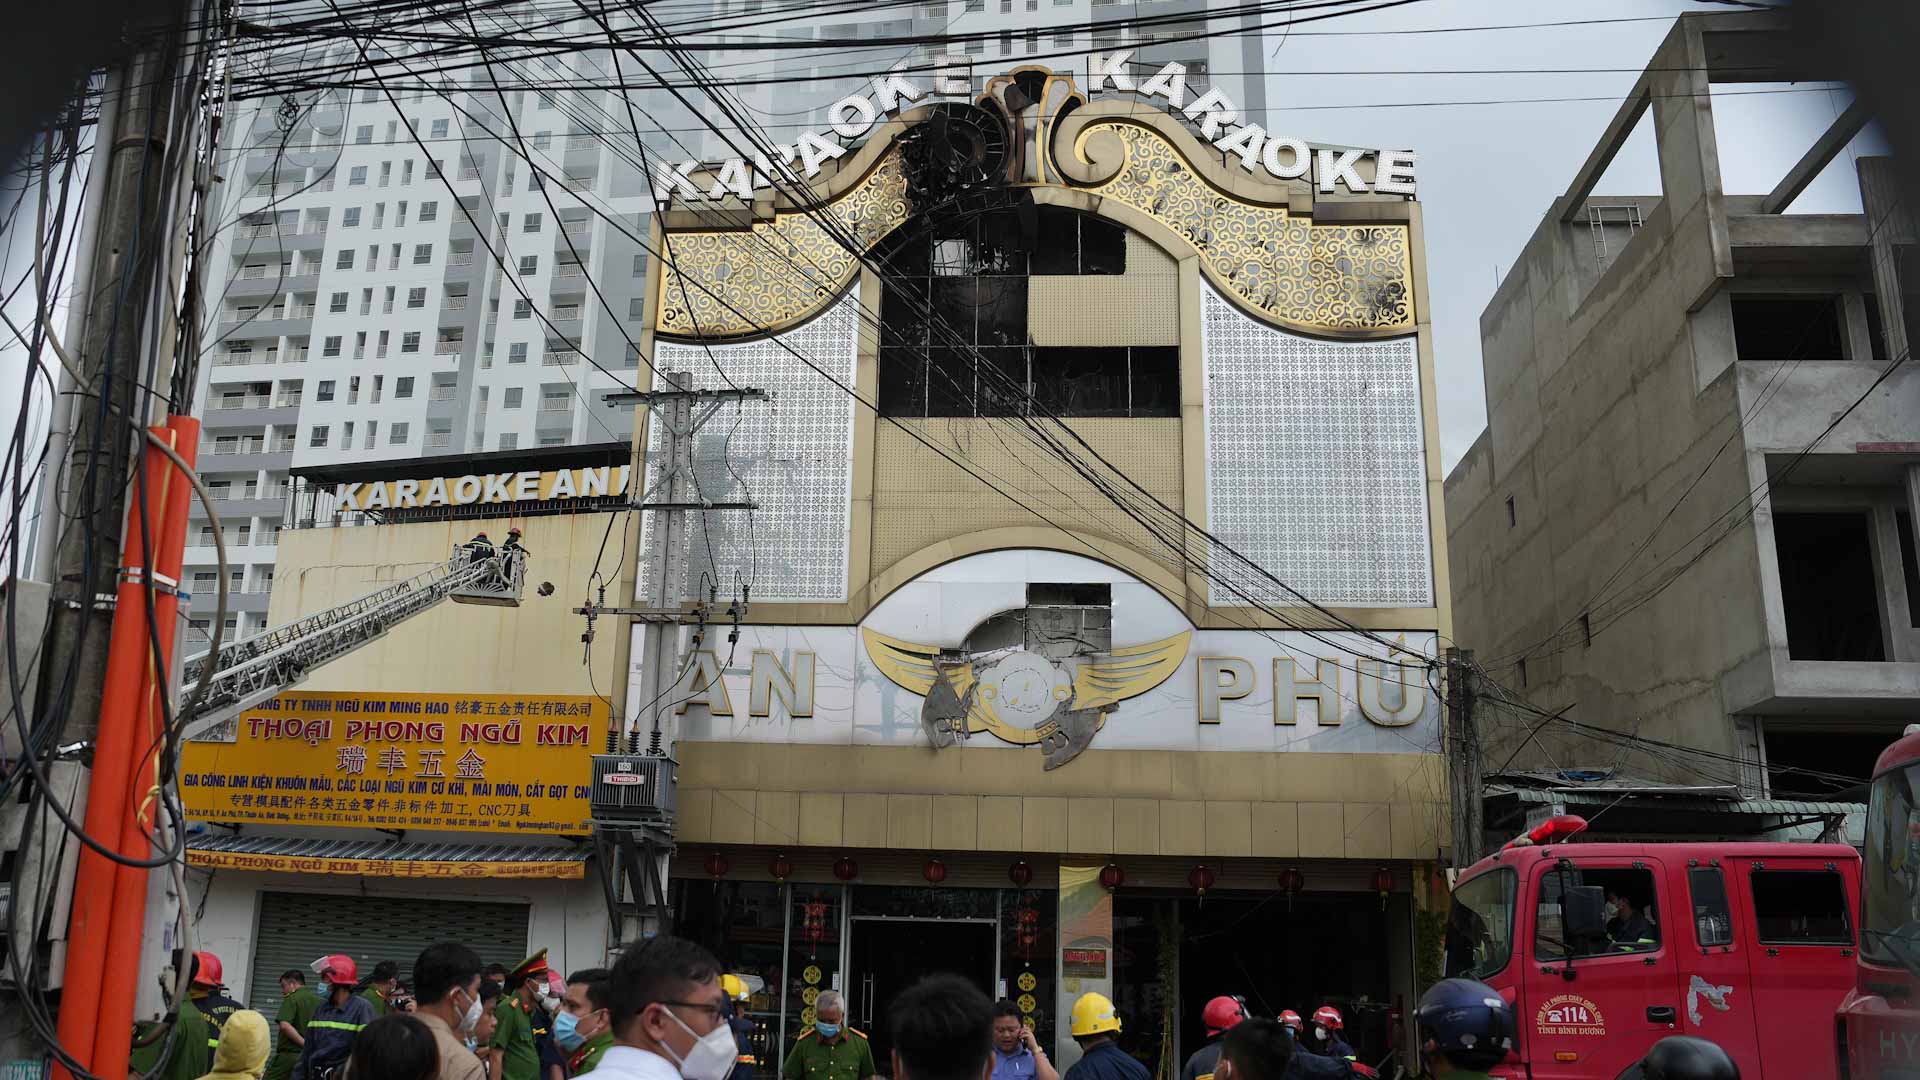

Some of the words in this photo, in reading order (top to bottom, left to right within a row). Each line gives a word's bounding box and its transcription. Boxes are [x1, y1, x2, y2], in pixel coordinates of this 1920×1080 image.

[655, 54, 973, 201] KARAOKE
[1087, 50, 1417, 194] KARAOKE
[335, 471, 541, 512] KARAOKE
[674, 649, 816, 718] AN
[1198, 632, 1426, 727] PHÚ
[285, 699, 299, 711] TY
[301, 700, 333, 712] TNHH
[363, 701, 387, 713] KIM
[389, 701, 421, 714] MING
[425, 702, 449, 715] HAO
[247, 717, 334, 746] THOẠI
[345, 719, 445, 744] PHONG
[459, 718, 522, 745] NGŨ
[536, 723, 590, 746] KIM
[336, 745, 486, 779] 瑞丰五金
[184, 773, 199, 787] GIA
[201, 772, 225, 788] CÔNG
[228, 775, 249, 788] LINH
[251, 774, 273, 791] KIỆN
[275, 775, 307, 791] KHUÔN
[359, 779, 381, 795] LOẠI
[408, 781, 427, 795] KIM
[549, 785, 569, 801] GỌT
[574, 785, 592, 799] CN
[233, 857, 285, 869] PHONG
[328, 862, 360, 872] KIM
[1562, 1006, 1588, 1023] 114
[1559, 1025, 1577, 1035] BÌNH
